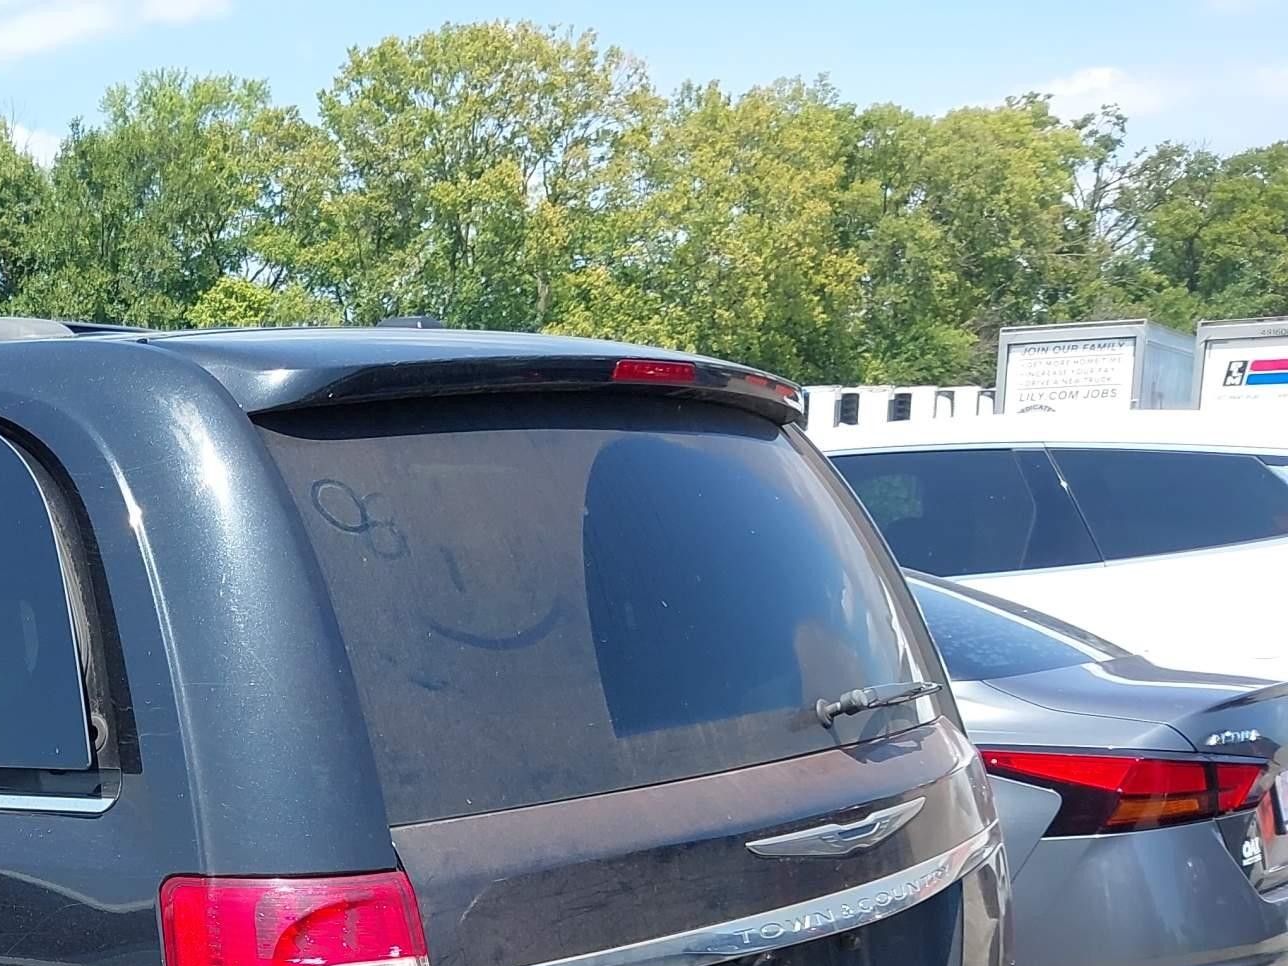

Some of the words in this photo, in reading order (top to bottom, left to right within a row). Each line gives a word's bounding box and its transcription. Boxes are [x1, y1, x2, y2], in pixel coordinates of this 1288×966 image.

[1021, 346, 1049, 356] JOIN
[1052, 344, 1079, 354] OUR
[1082, 342, 1126, 352] FAMILY
[1083, 388, 1118, 400] JOBS
[733, 908, 835, 944] TOWN
[840, 904, 855, 919] &
[858, 862, 951, 914] COUNTRY
